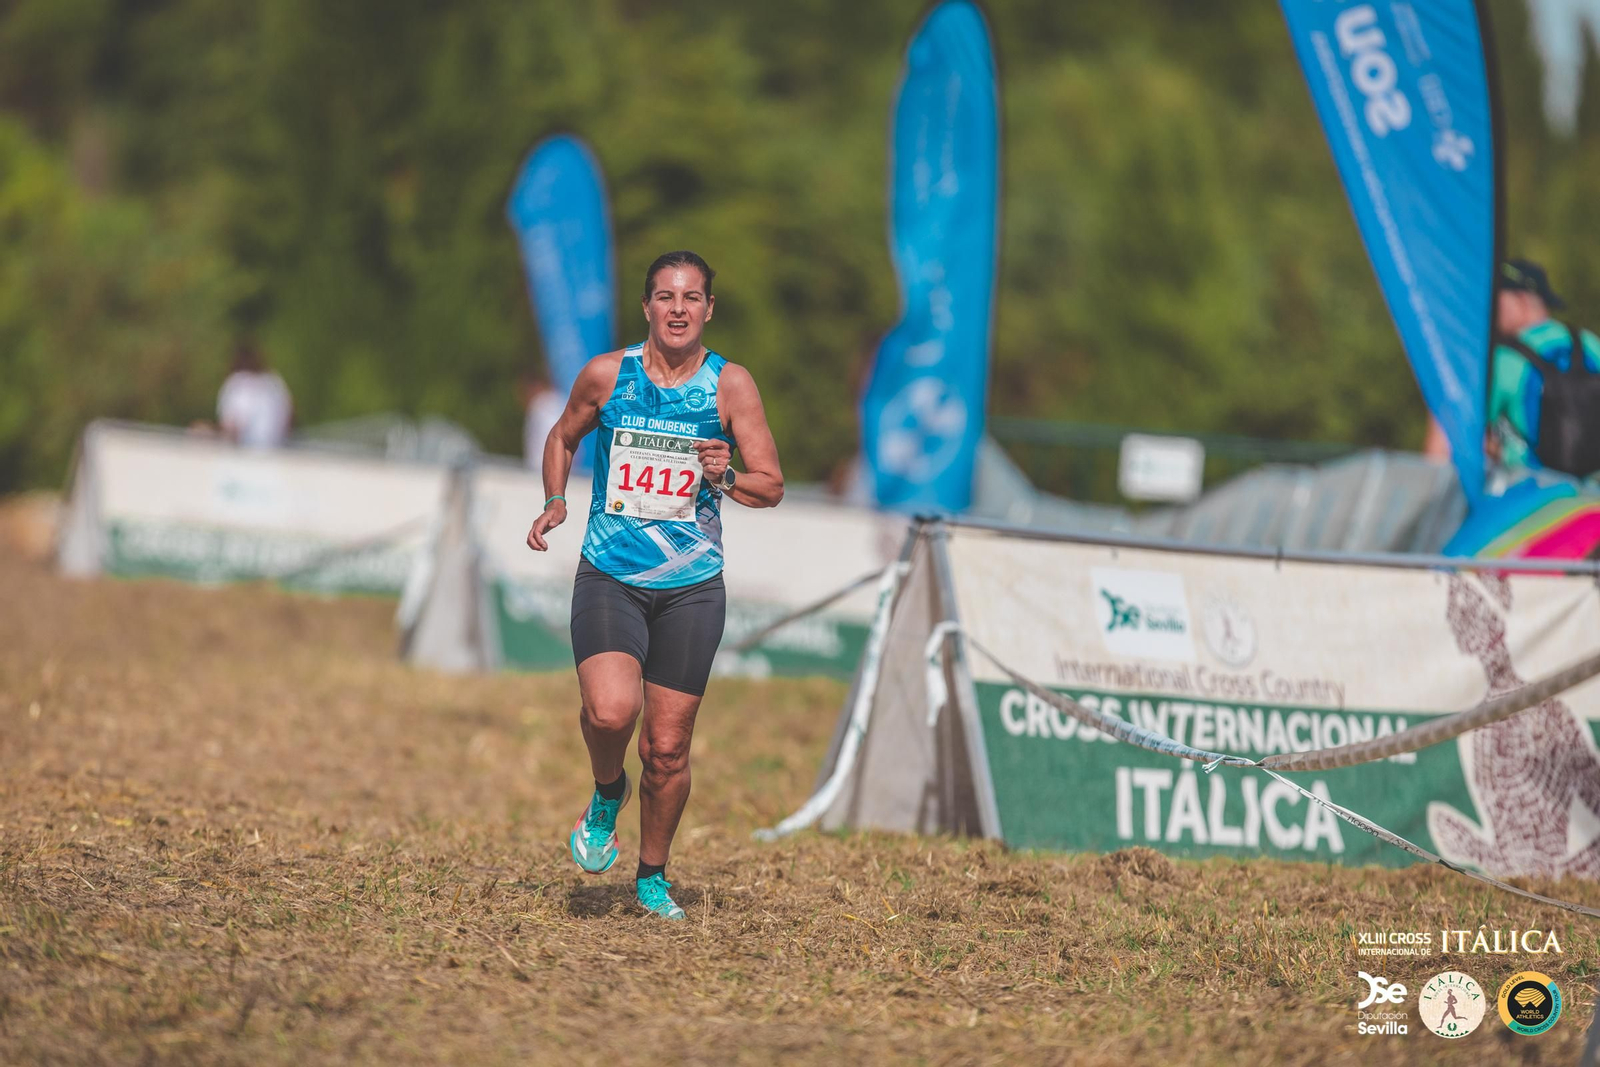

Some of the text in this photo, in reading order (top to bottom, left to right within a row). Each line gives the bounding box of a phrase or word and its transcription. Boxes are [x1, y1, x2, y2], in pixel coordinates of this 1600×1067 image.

[621, 415, 698, 436] CLUB ONUBENSE
[638, 435, 682, 450] ITÁLICA
[618, 463, 695, 497] 1412
[1054, 652, 1345, 710] International Cross Country
[1001, 689, 1121, 745] CROSS
[1115, 757, 1345, 853] ITÁLICA
